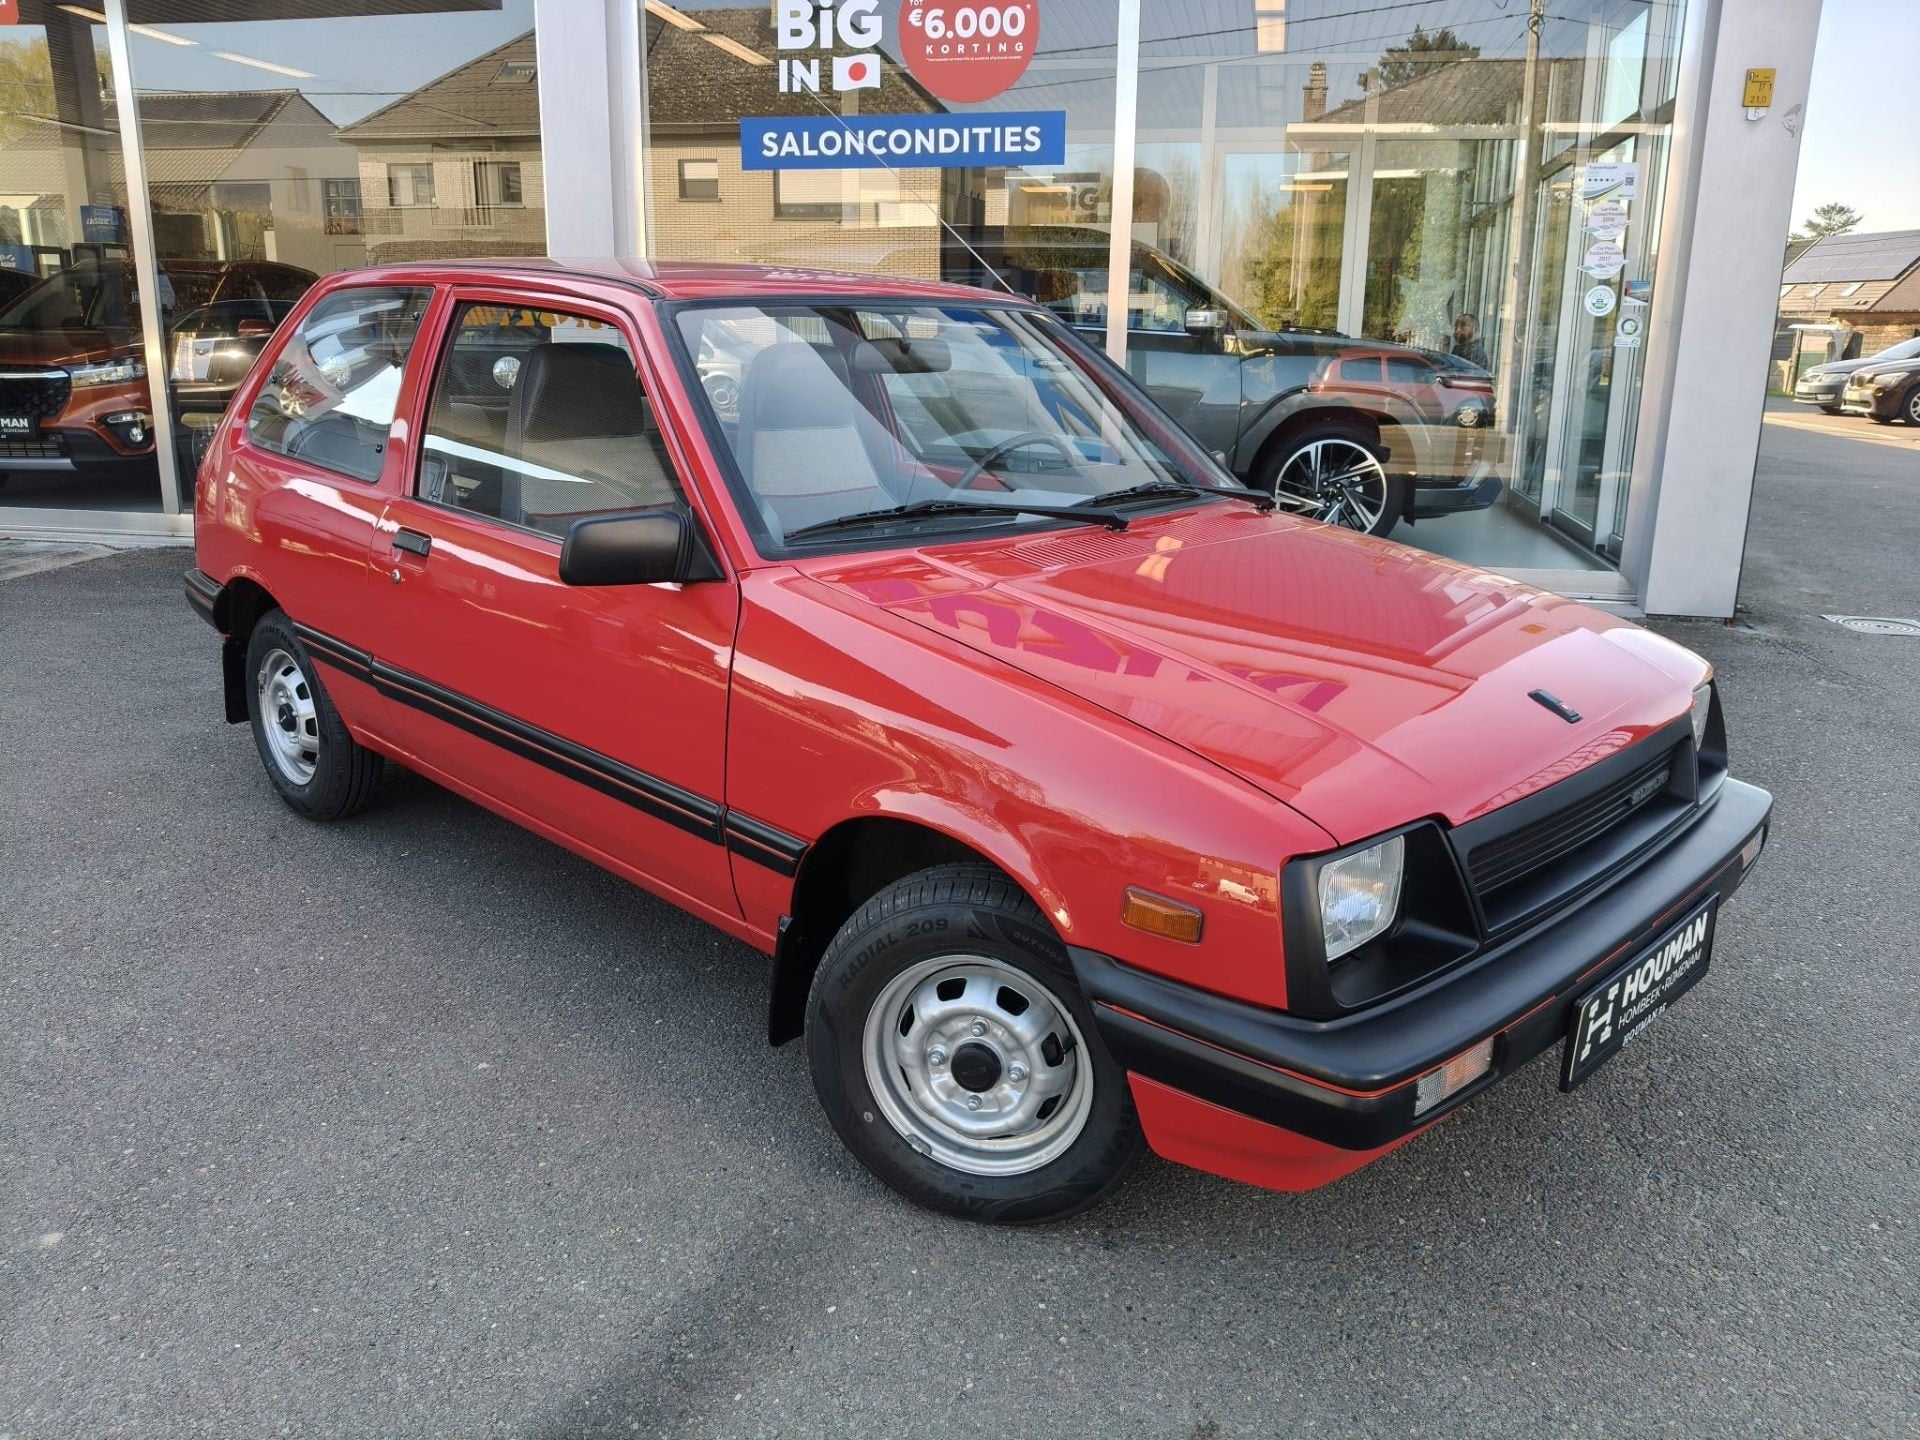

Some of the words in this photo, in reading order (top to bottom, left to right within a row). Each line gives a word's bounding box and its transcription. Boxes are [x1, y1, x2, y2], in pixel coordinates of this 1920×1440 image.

[778, 0, 882, 49] BiG
[925, 42, 1024, 54] KORTING
[779, 59, 820, 92] IN
[761, 126, 1042, 157] SALONCONDITIES
[838, 930, 900, 990] RADIAL
[906, 917, 948, 937] 209
[1621, 911, 1708, 1008] HOUMAN
